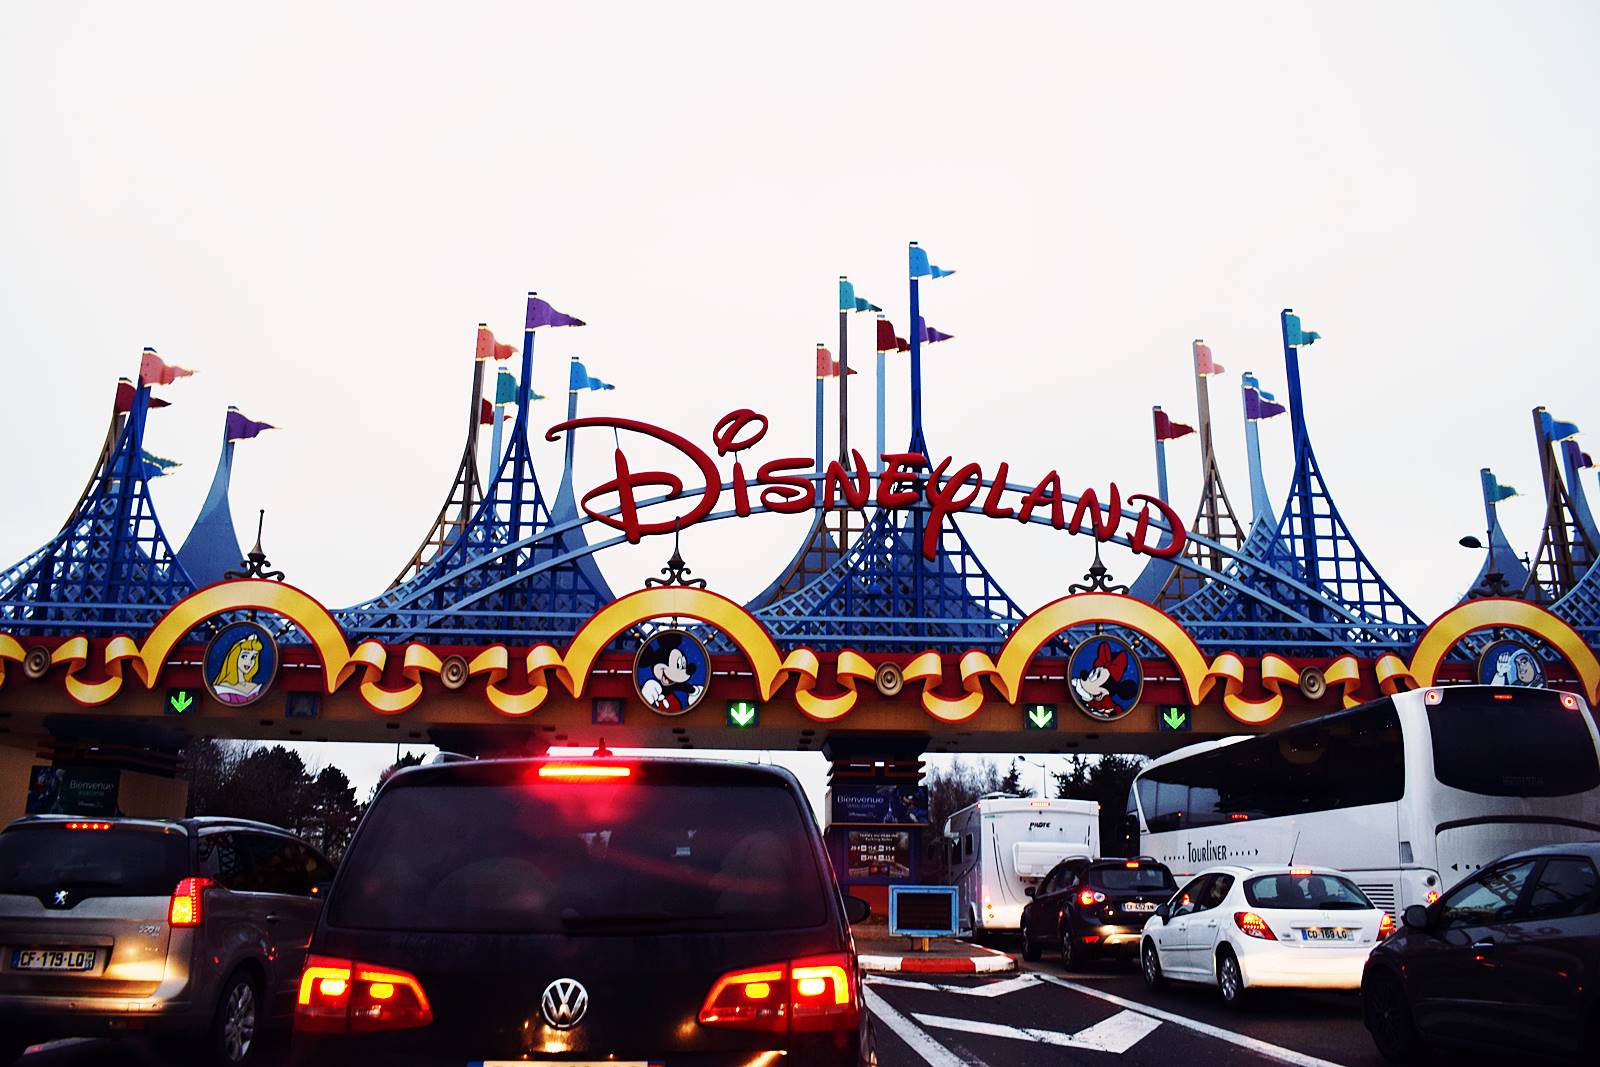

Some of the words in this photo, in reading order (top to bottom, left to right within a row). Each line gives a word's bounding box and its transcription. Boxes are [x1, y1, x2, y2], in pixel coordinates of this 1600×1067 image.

[545, 409, 1187, 561] DISNEYLAND
[70, 780, 114, 790] Bienvenue
[837, 795, 884, 804] Bienvenue
